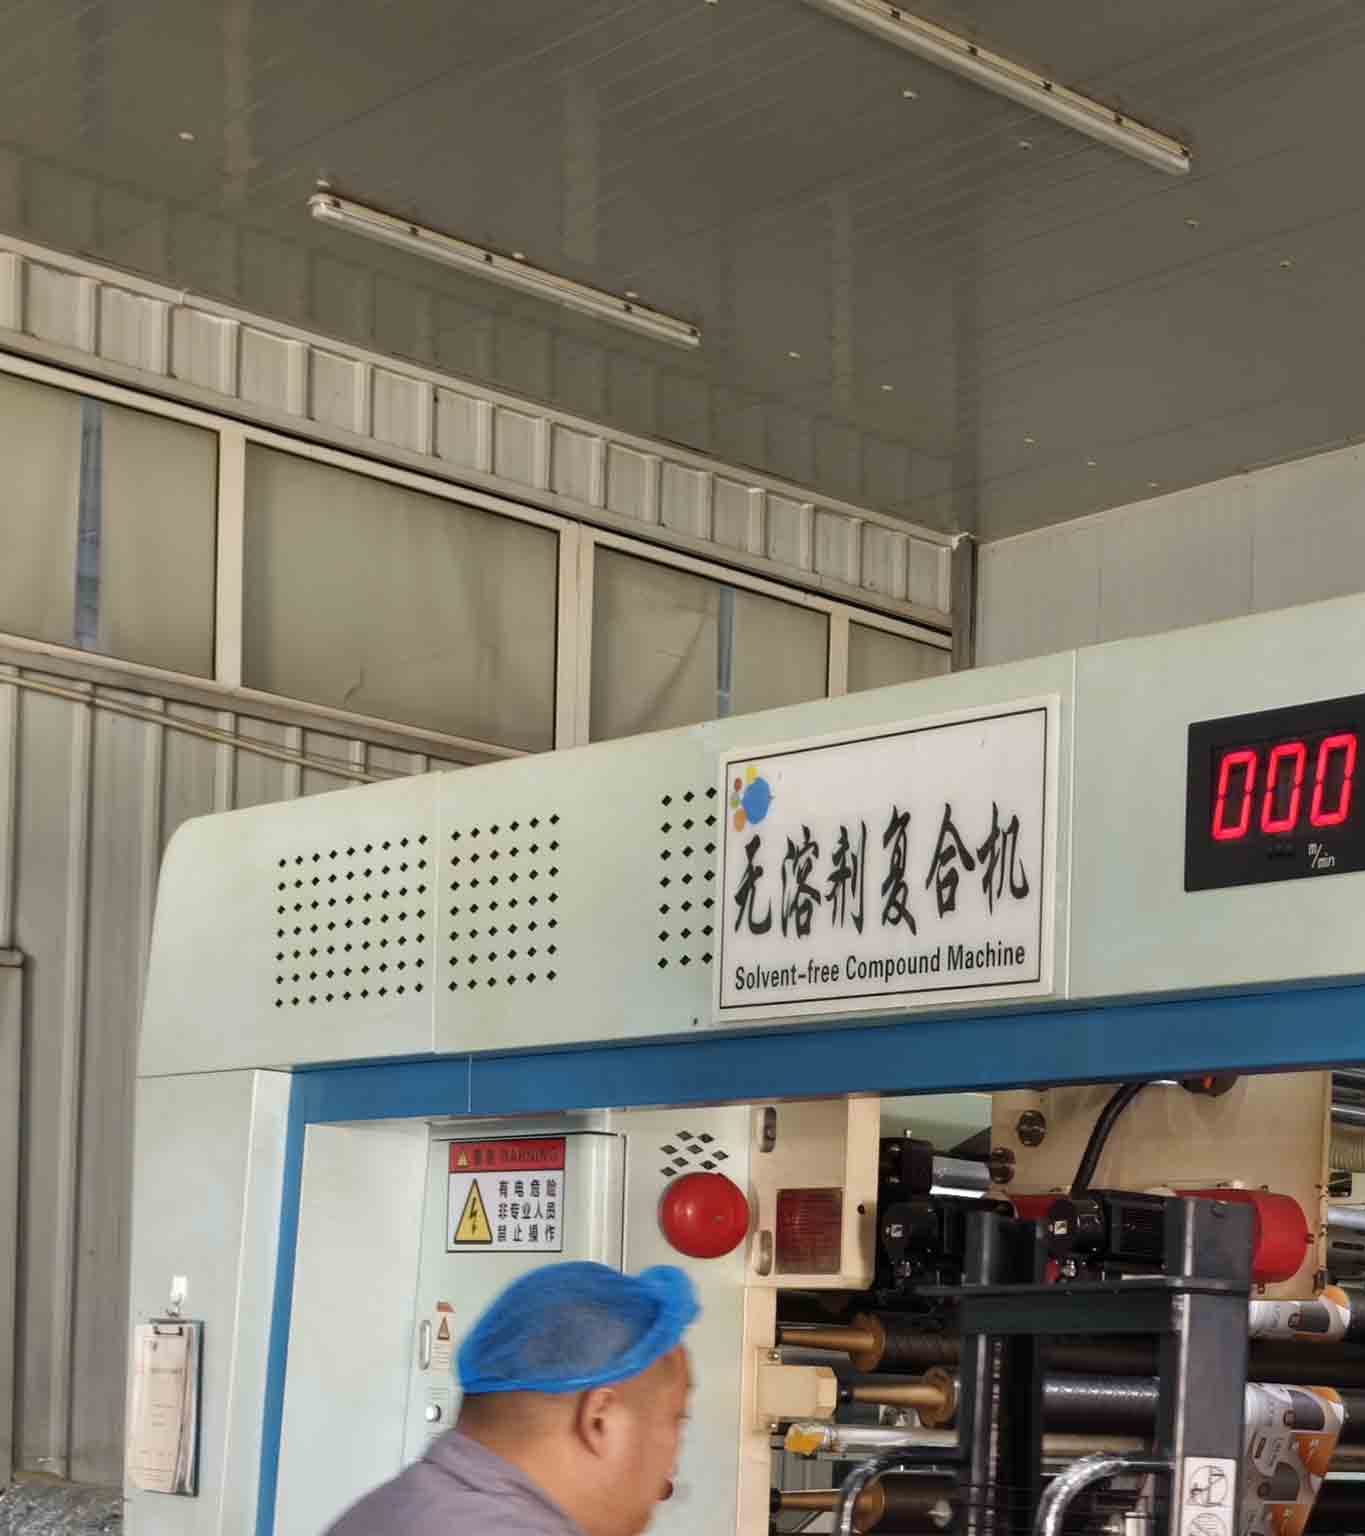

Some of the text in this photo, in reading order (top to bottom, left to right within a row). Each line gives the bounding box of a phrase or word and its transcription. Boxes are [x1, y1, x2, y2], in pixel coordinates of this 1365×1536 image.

[1212, 733, 1358, 842] 000
[734, 801, 1029, 939] 无溶剂复合机
[735, 940, 1026, 991] Solvent-free Compound Machine
[497, 1202, 556, 1220] 非专业人员
